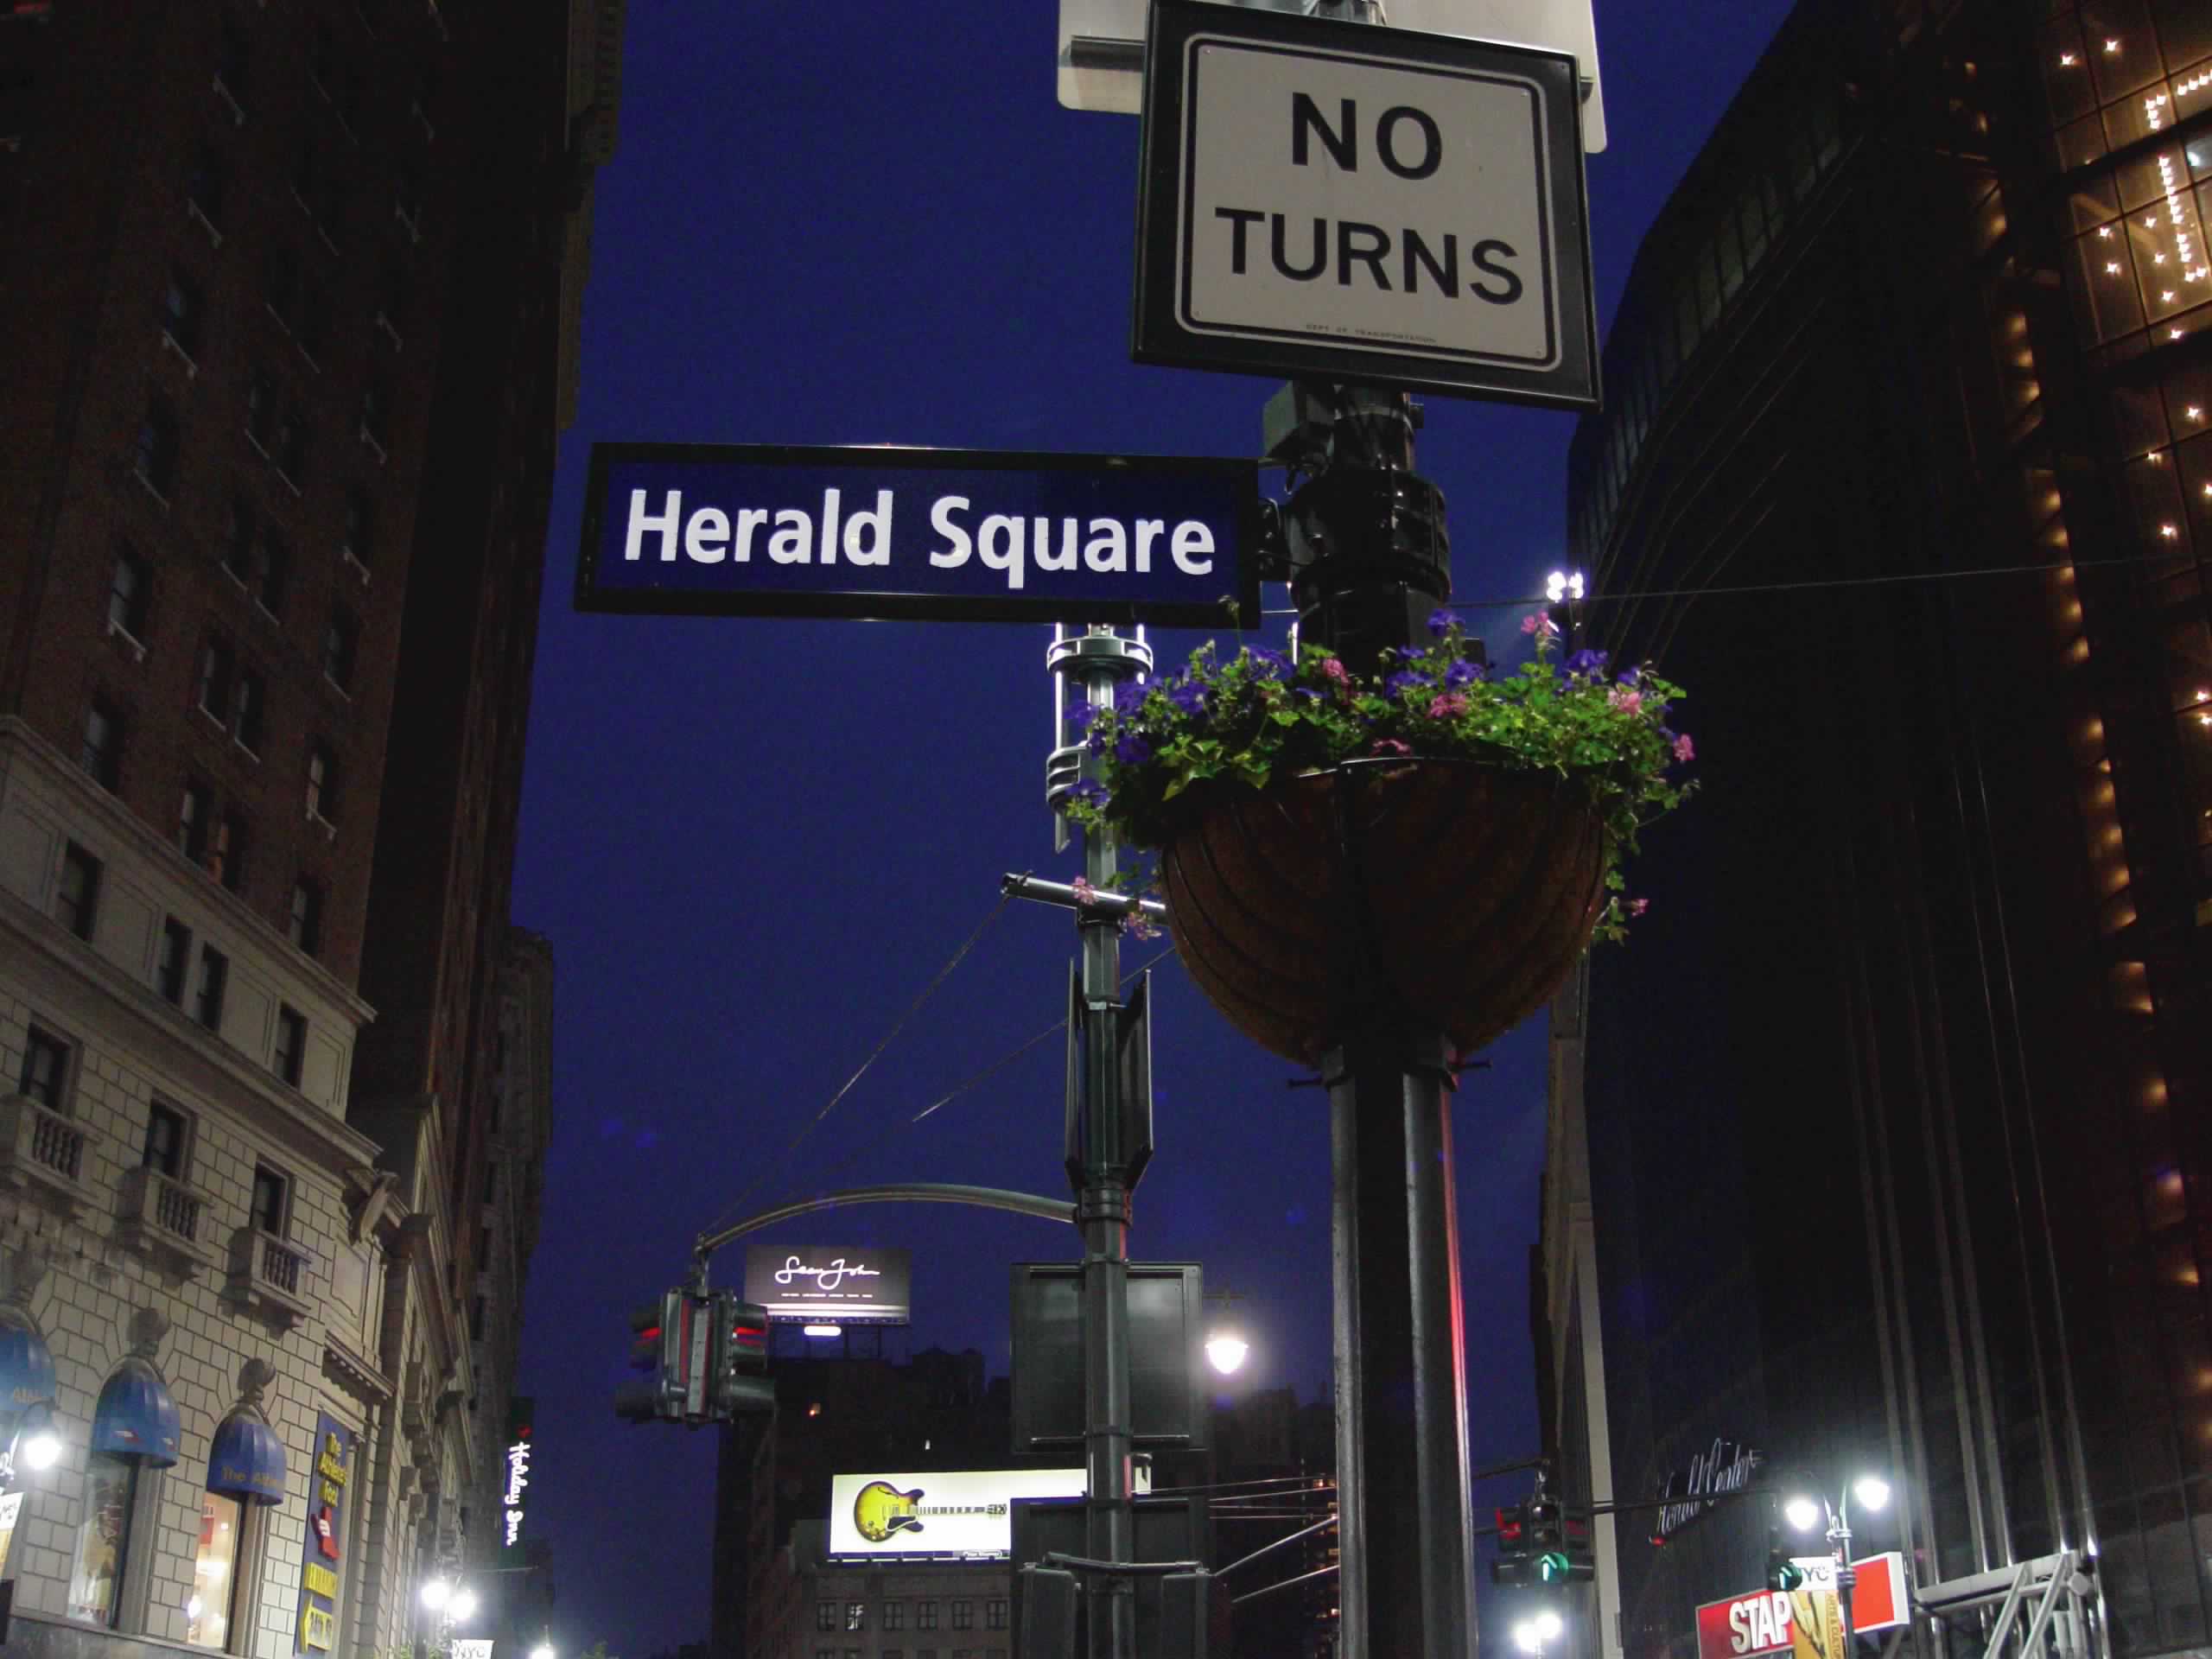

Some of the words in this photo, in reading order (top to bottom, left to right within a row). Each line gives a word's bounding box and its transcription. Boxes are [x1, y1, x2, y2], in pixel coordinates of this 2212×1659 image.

[1292, 92, 1442, 180] NO
[1215, 207, 1522, 304] TURNS
[624, 488, 893, 566] Herald
[930, 495, 1216, 588] Square
[504, 1441, 531, 1504] Holiday
[506, 1510, 524, 1546] Inn
